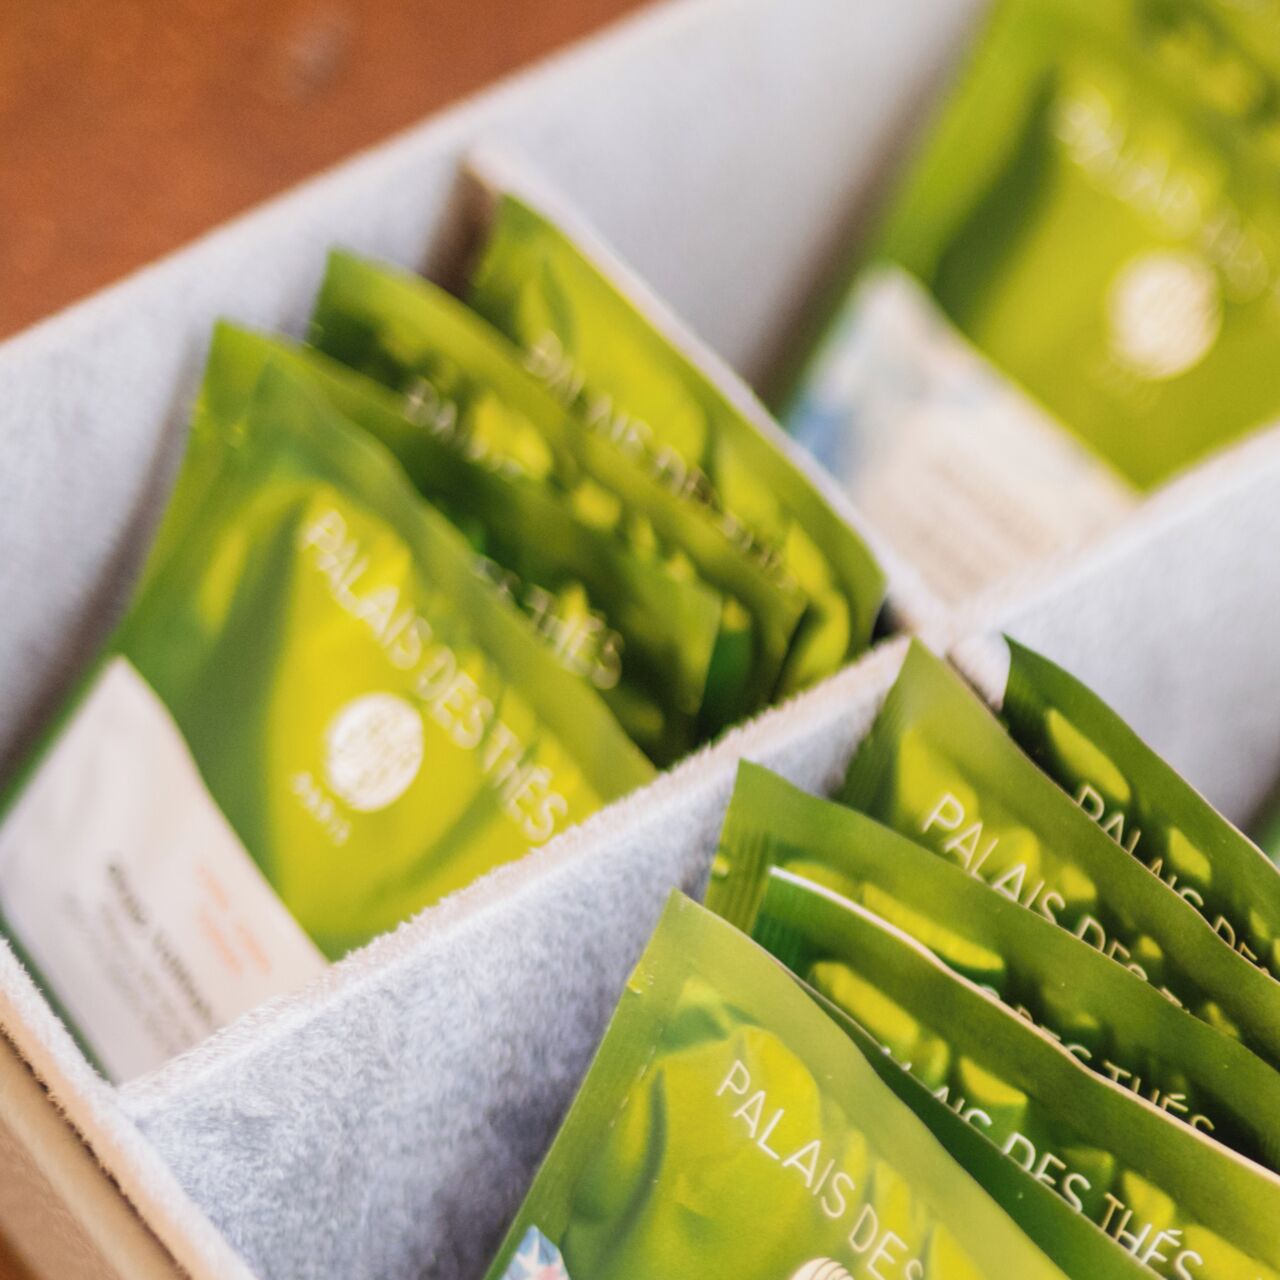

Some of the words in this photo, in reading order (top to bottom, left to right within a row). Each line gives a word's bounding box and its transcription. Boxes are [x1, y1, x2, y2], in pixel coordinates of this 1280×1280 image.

[922, 793, 1067, 925] PALAIS
[716, 1059, 855, 1219] PALAIS
[1002, 1131, 1092, 1214] DES
